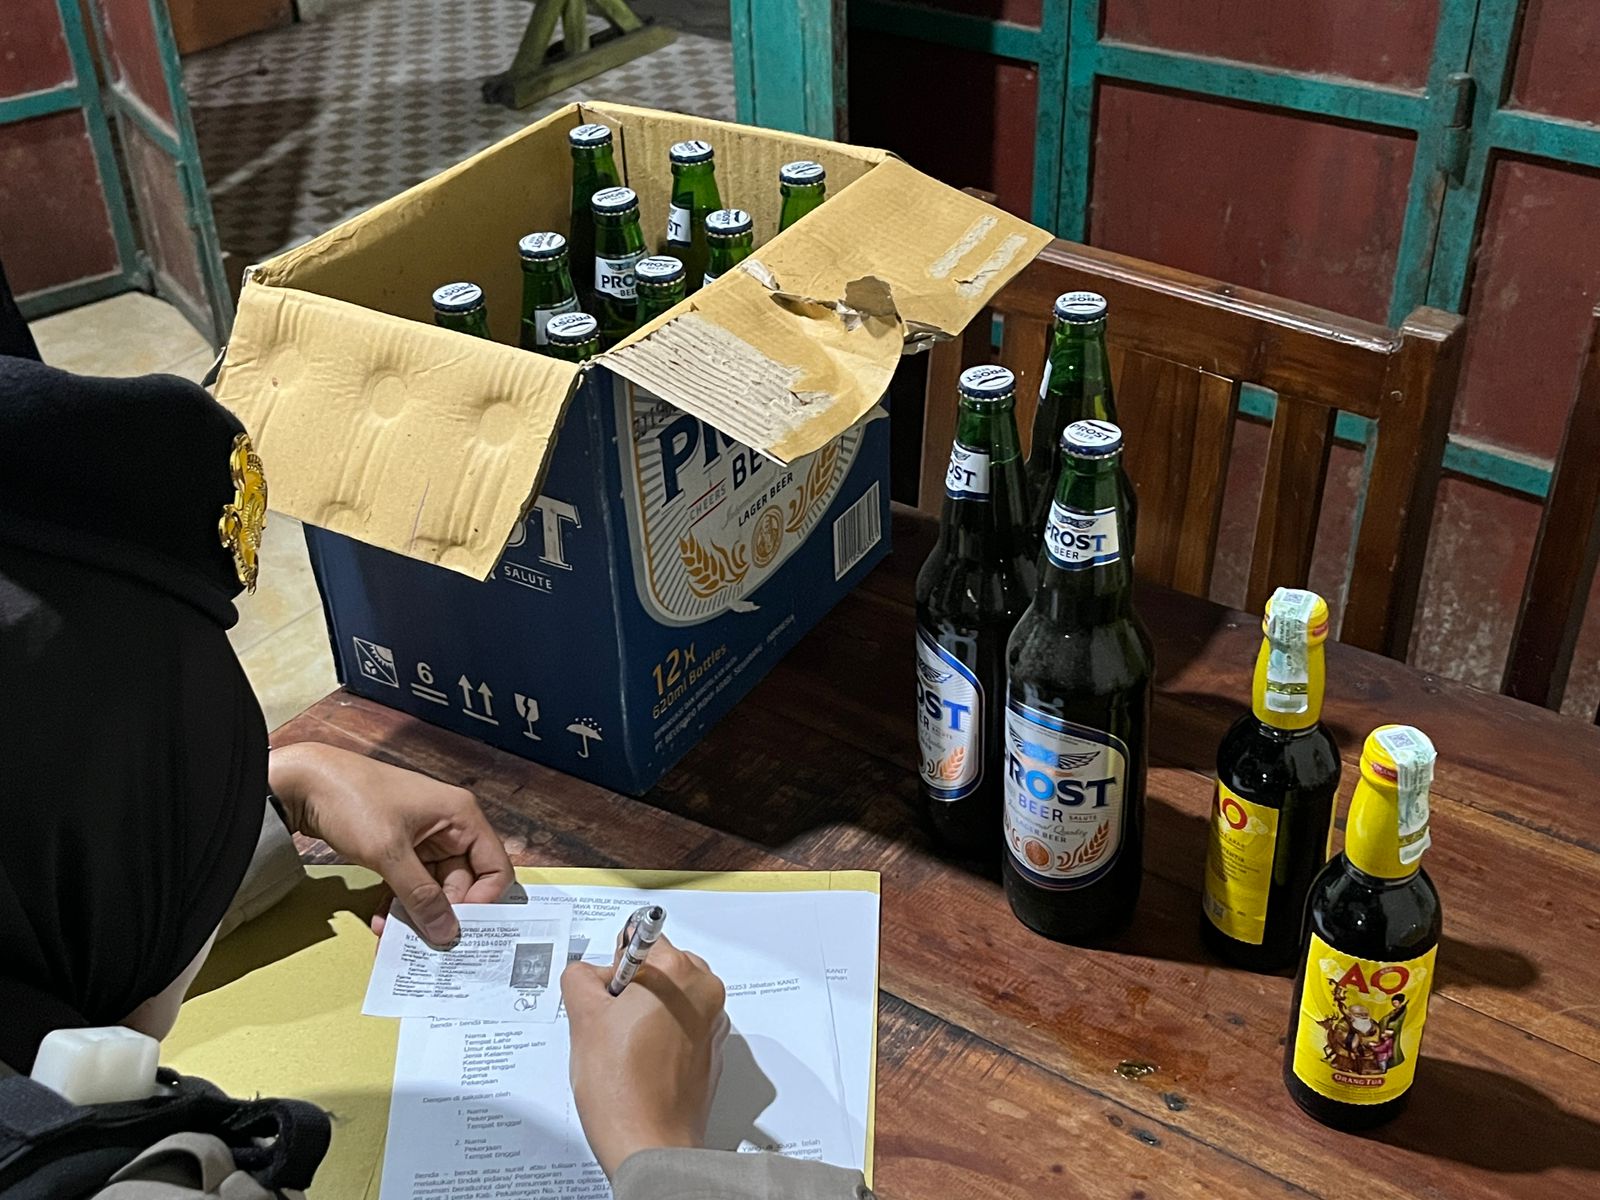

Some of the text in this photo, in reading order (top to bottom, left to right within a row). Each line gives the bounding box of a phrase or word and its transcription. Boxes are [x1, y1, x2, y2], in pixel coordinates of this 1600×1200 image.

[601, 273, 637, 289] PRO
[619, 289, 637, 297] BEE
[966, 368, 1007, 382] PROST
[1069, 423, 1114, 441] PROST
[689, 483, 727, 522] CHEERS
[738, 494, 768, 528] LAGER
[770, 471, 794, 499] BEER
[1054, 545, 1080, 560] BEER
[504, 564, 553, 590] SALUTE
[416, 661, 435, 685] 6
[1018, 792, 1064, 823] BEER
[1338, 962, 1410, 995] AO
